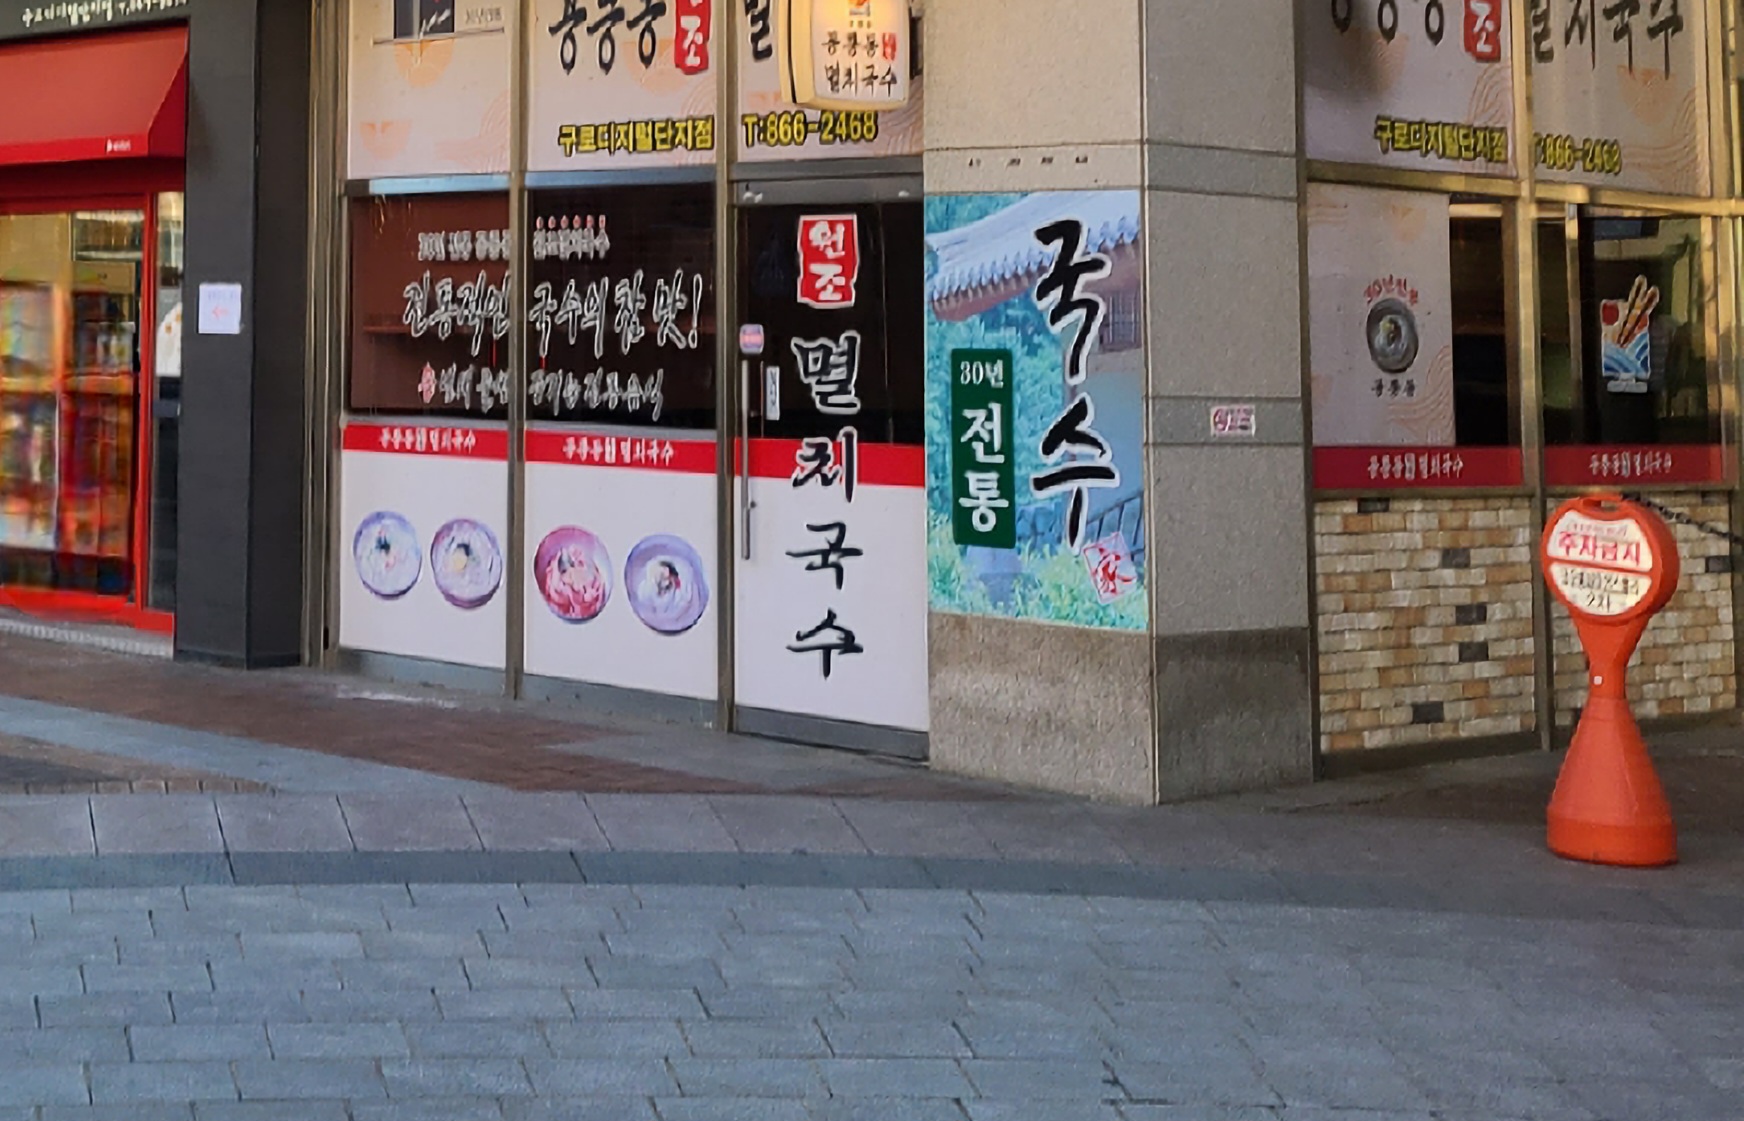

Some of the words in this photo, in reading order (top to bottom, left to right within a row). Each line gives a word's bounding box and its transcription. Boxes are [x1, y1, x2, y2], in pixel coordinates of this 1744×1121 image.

[559, 114, 714, 156] 구로디지털단지점
[803, 216, 852, 304] 원조
[960, 359, 1005, 389] 30년
[1030, 217, 1120, 554] 국수
[786, 330, 863, 679] 멸치국수
[959, 402, 1009, 533] 전통
